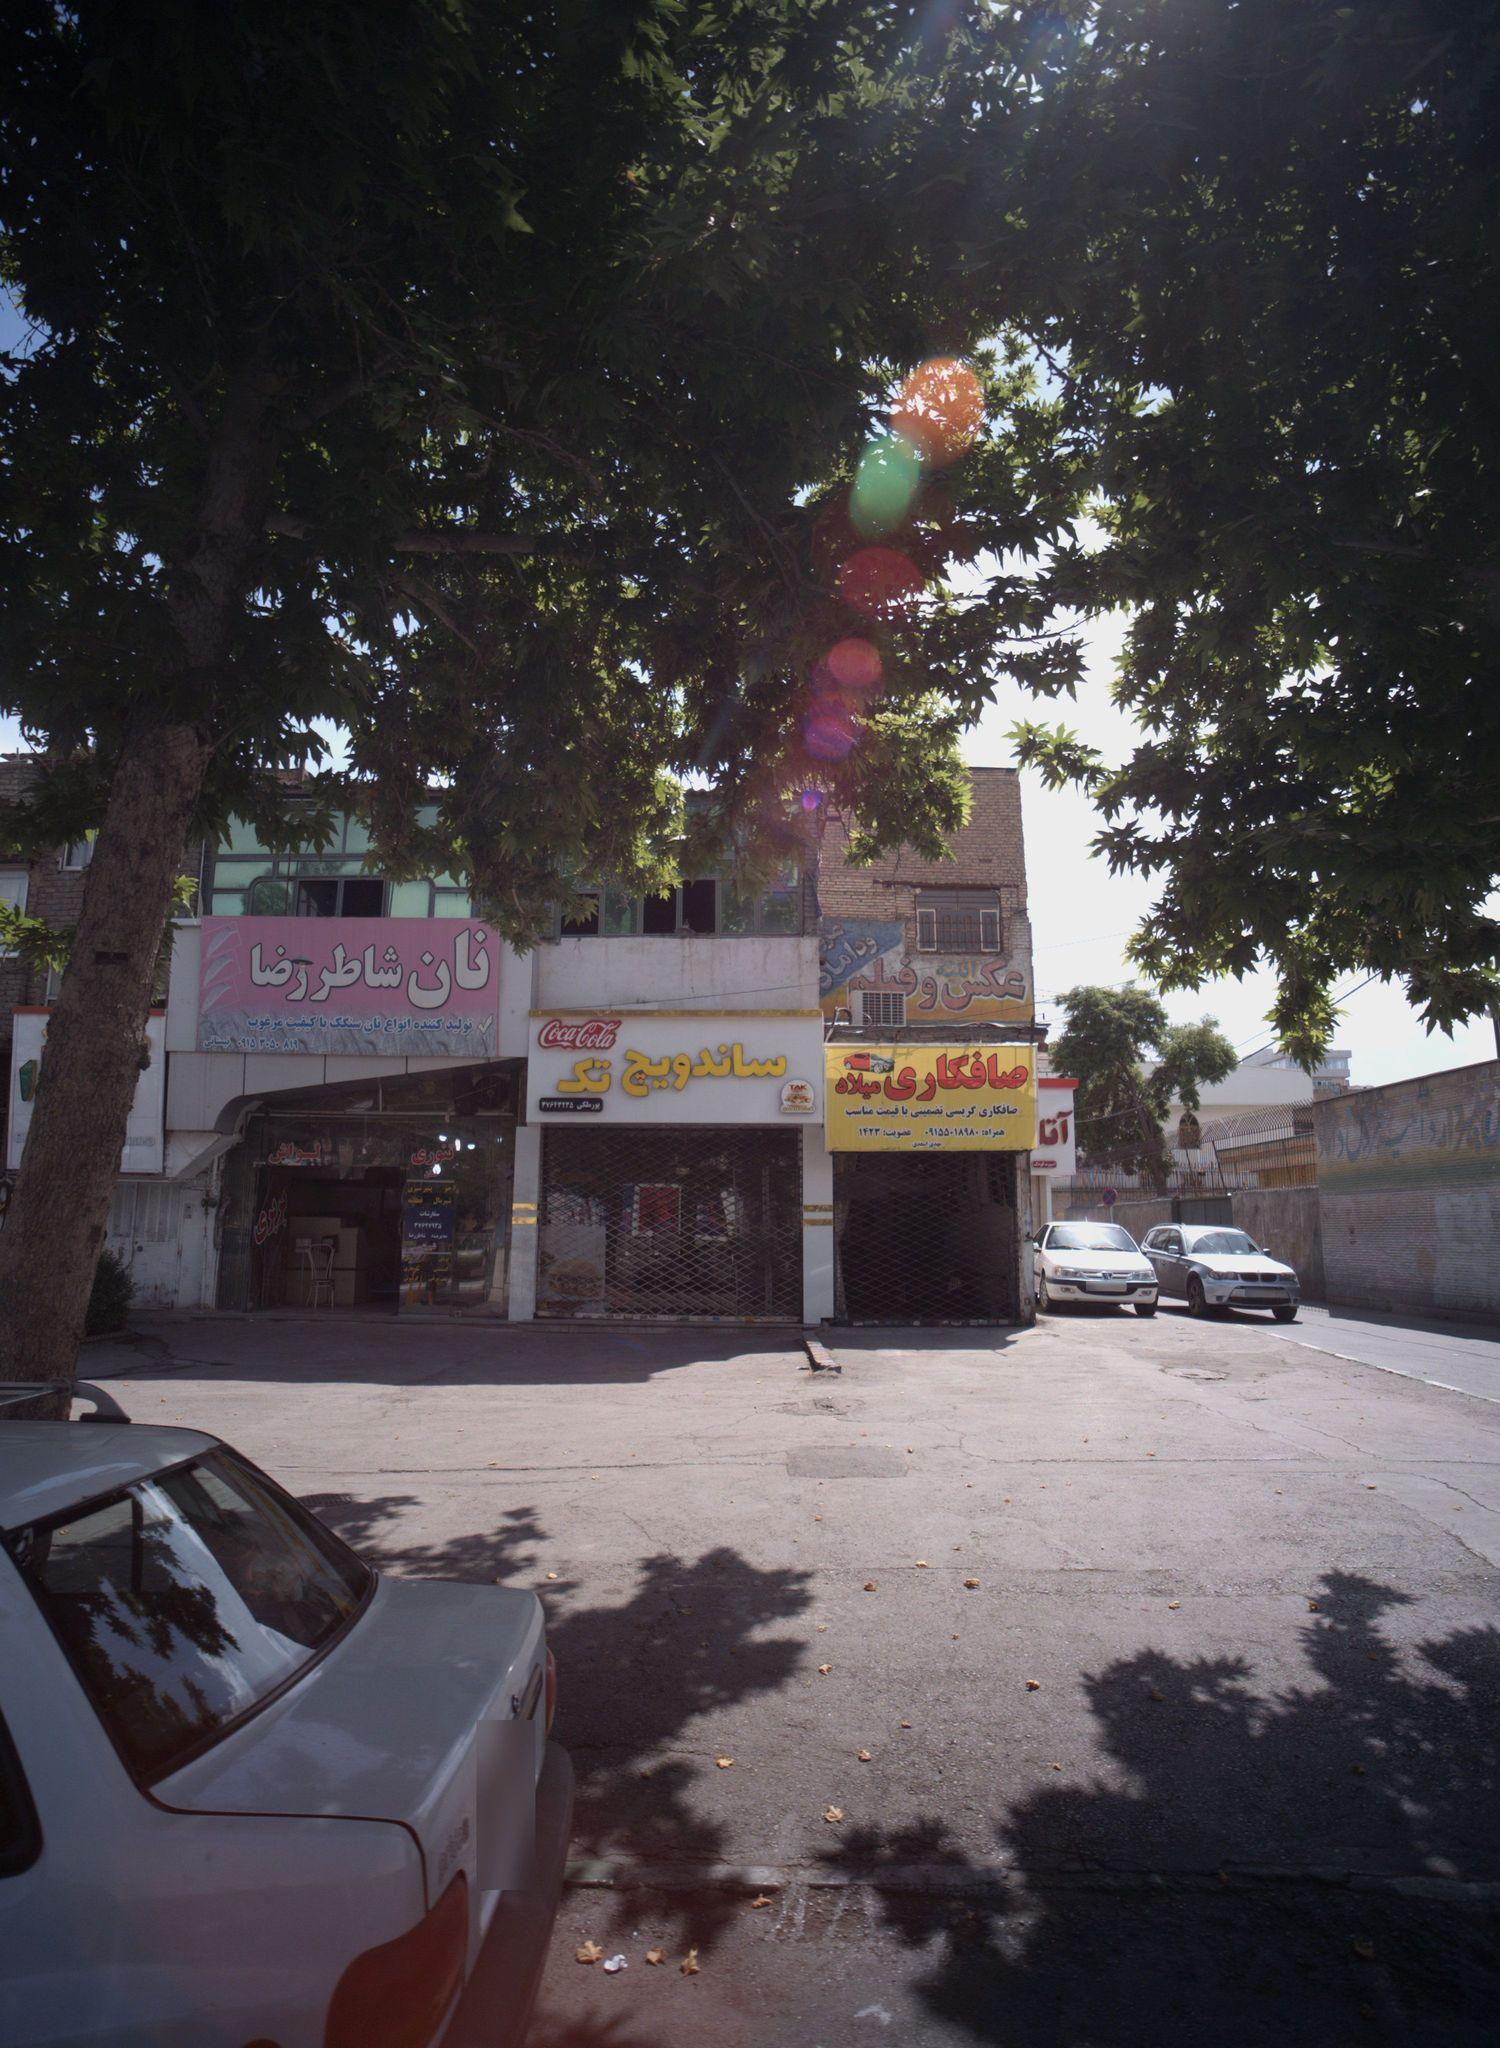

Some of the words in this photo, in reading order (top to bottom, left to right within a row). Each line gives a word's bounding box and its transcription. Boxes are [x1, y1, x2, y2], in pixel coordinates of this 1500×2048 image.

[250, 943, 310, 1001] رضا
[309, 943, 403, 1001] شاطر
[407, 928, 490, 1009] نان
[940, 957, 1026, 1011] عکس
[918, 976, 938, 1010] و
[247, 1016, 283, 1031] مرغوب
[286, 1016, 316, 1030] کیفیت
[318, 1017, 327, 1029] با
[363, 1017, 381, 1034] نان
[384, 1017, 411, 1034] انواع
[413, 1016, 445, 1031] کننده
[446, 1016, 473, 1034] تولید
[538, 1019, 621, 1050] Coca-Cola
[557, 1056, 612, 1093] تک
[621, 1042, 787, 1097] ساندویچ
[884, 1050, 1029, 1101] صافکاری
[845, 1105, 874, 1118] مناسب
[876, 1105, 899, 1117] قیمت
[901, 1105, 908, 1116] با
[911, 1105, 943, 1118] تضمینی
[979, 1105, 1018, 1118] صافکاری
